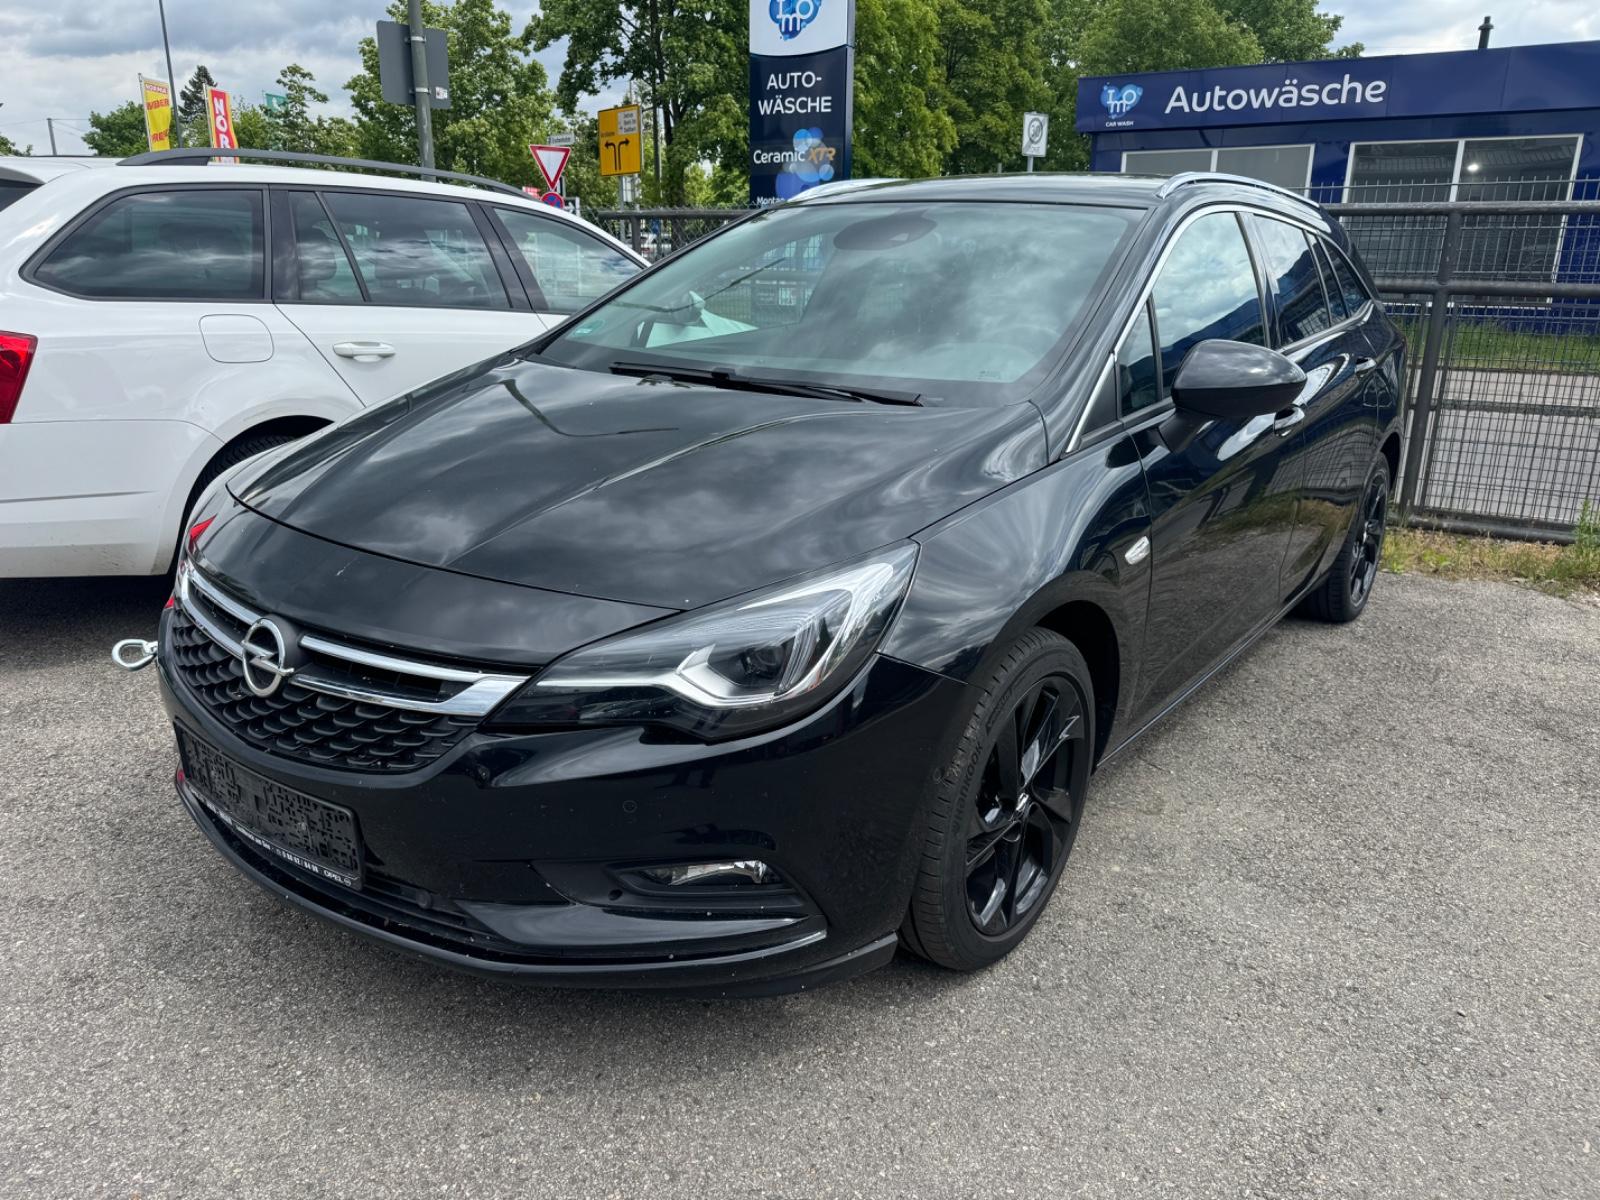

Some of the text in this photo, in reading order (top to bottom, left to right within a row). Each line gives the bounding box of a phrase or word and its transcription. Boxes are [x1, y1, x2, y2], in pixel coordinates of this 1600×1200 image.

[766, 71, 822, 90] AUTO-
[1165, 73, 1387, 114] Autowäsche
[757, 95, 832, 115] WÄSCHE
